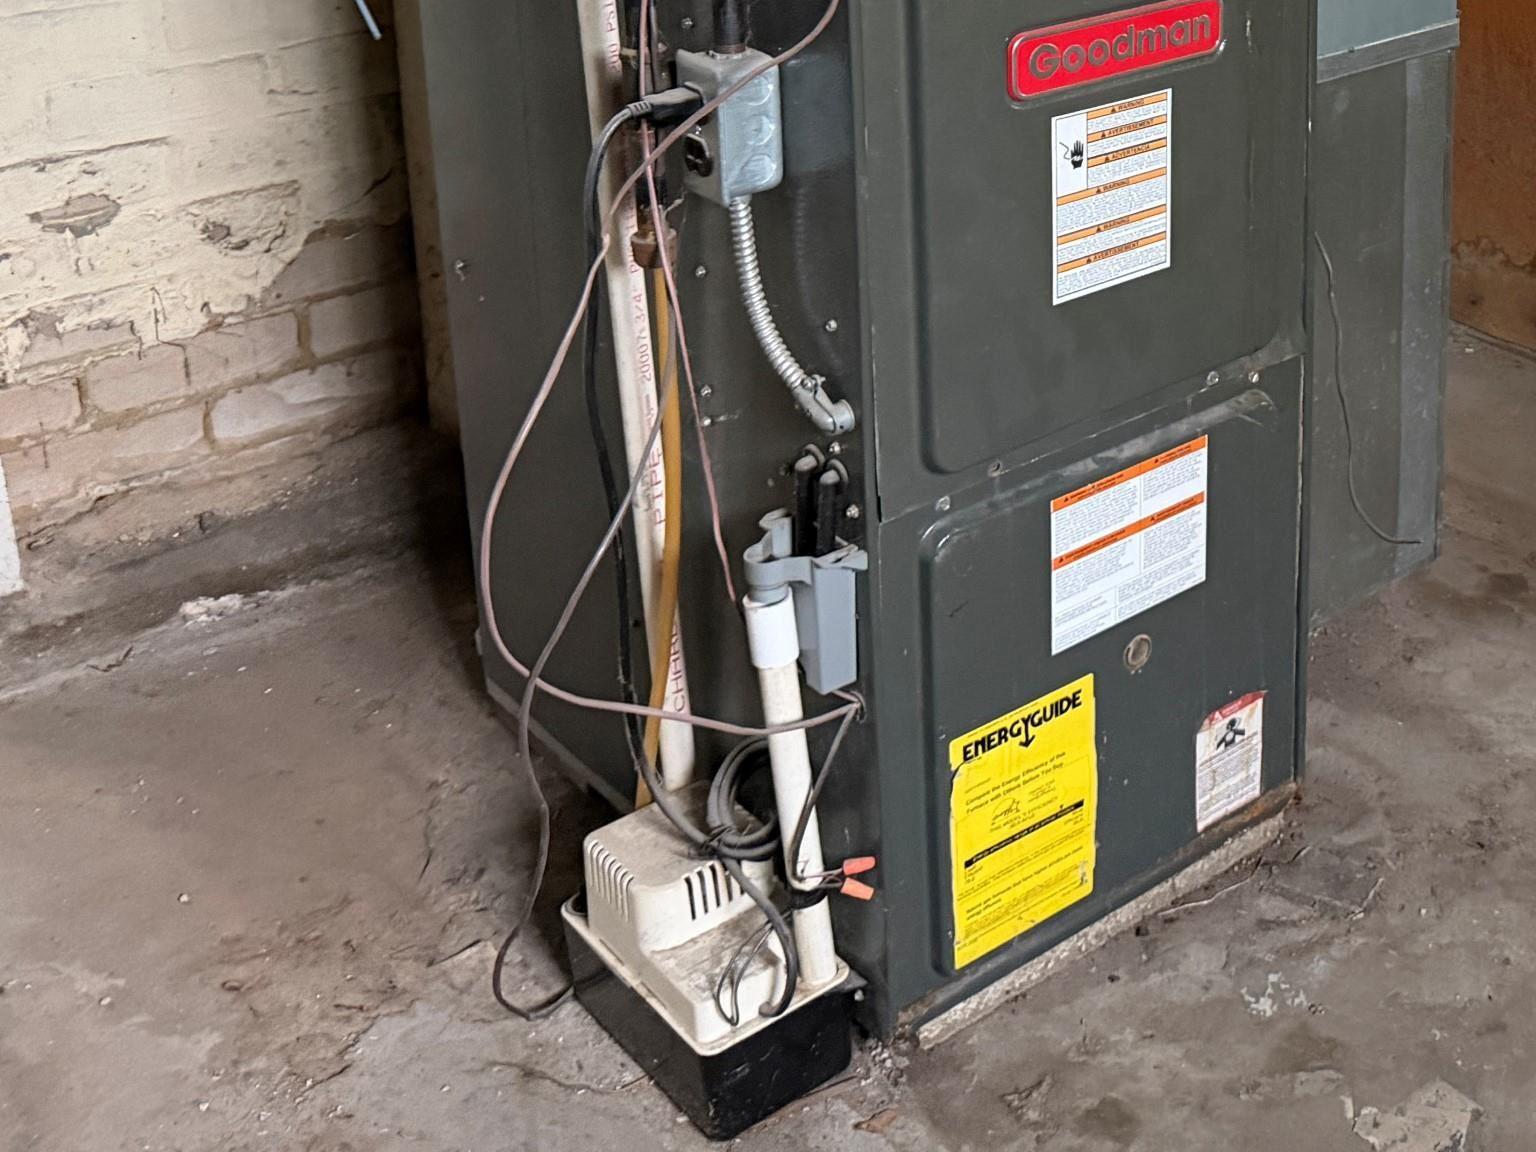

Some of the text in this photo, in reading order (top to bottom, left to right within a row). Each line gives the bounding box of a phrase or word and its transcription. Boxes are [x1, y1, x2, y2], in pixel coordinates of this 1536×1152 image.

[603, 2, 616, 33] PSI
[1028, 14, 1212, 80] Goodman
[648, 448, 666, 527] PIPE
[962, 688, 1083, 762] ENERGYGUIDE
